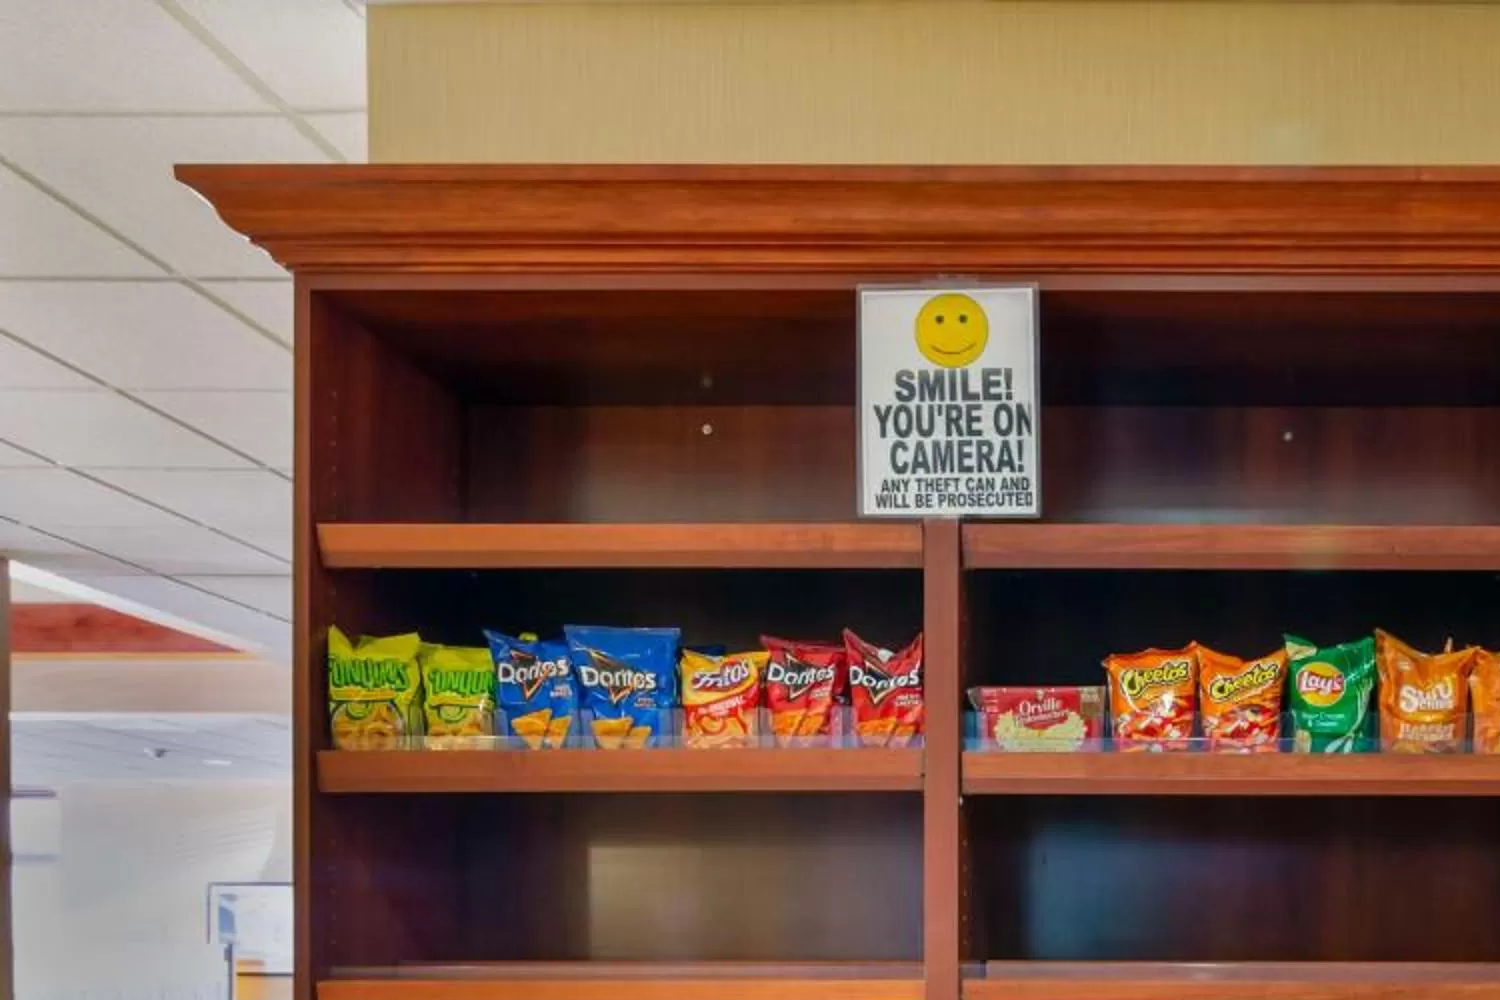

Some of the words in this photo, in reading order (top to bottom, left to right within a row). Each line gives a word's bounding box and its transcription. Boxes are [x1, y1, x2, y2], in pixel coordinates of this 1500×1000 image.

[894, 367, 1014, 403] SMILE!
[873, 404, 984, 439] YOU'RE
[993, 403, 1032, 437] ON
[890, 440, 1025, 475] CAMERA!
[881, 478, 911, 493] ANY
[914, 478, 961, 492] THEFT
[965, 478, 996, 492] CAN
[1000, 477, 1030, 491] AND
[875, 494, 911, 509] WILL
[915, 494, 933, 508] BE
[938, 492, 1033, 508] PROSECUTED
[497, 658, 570, 684] Doritos
[580, 665, 657, 690] Doritos
[767, 661, 836, 685] Doritos
[850, 664, 920, 690] Doritos
[1121, 660, 1190, 696] Cheetos
[1210, 663, 1280, 699] Cheetos
